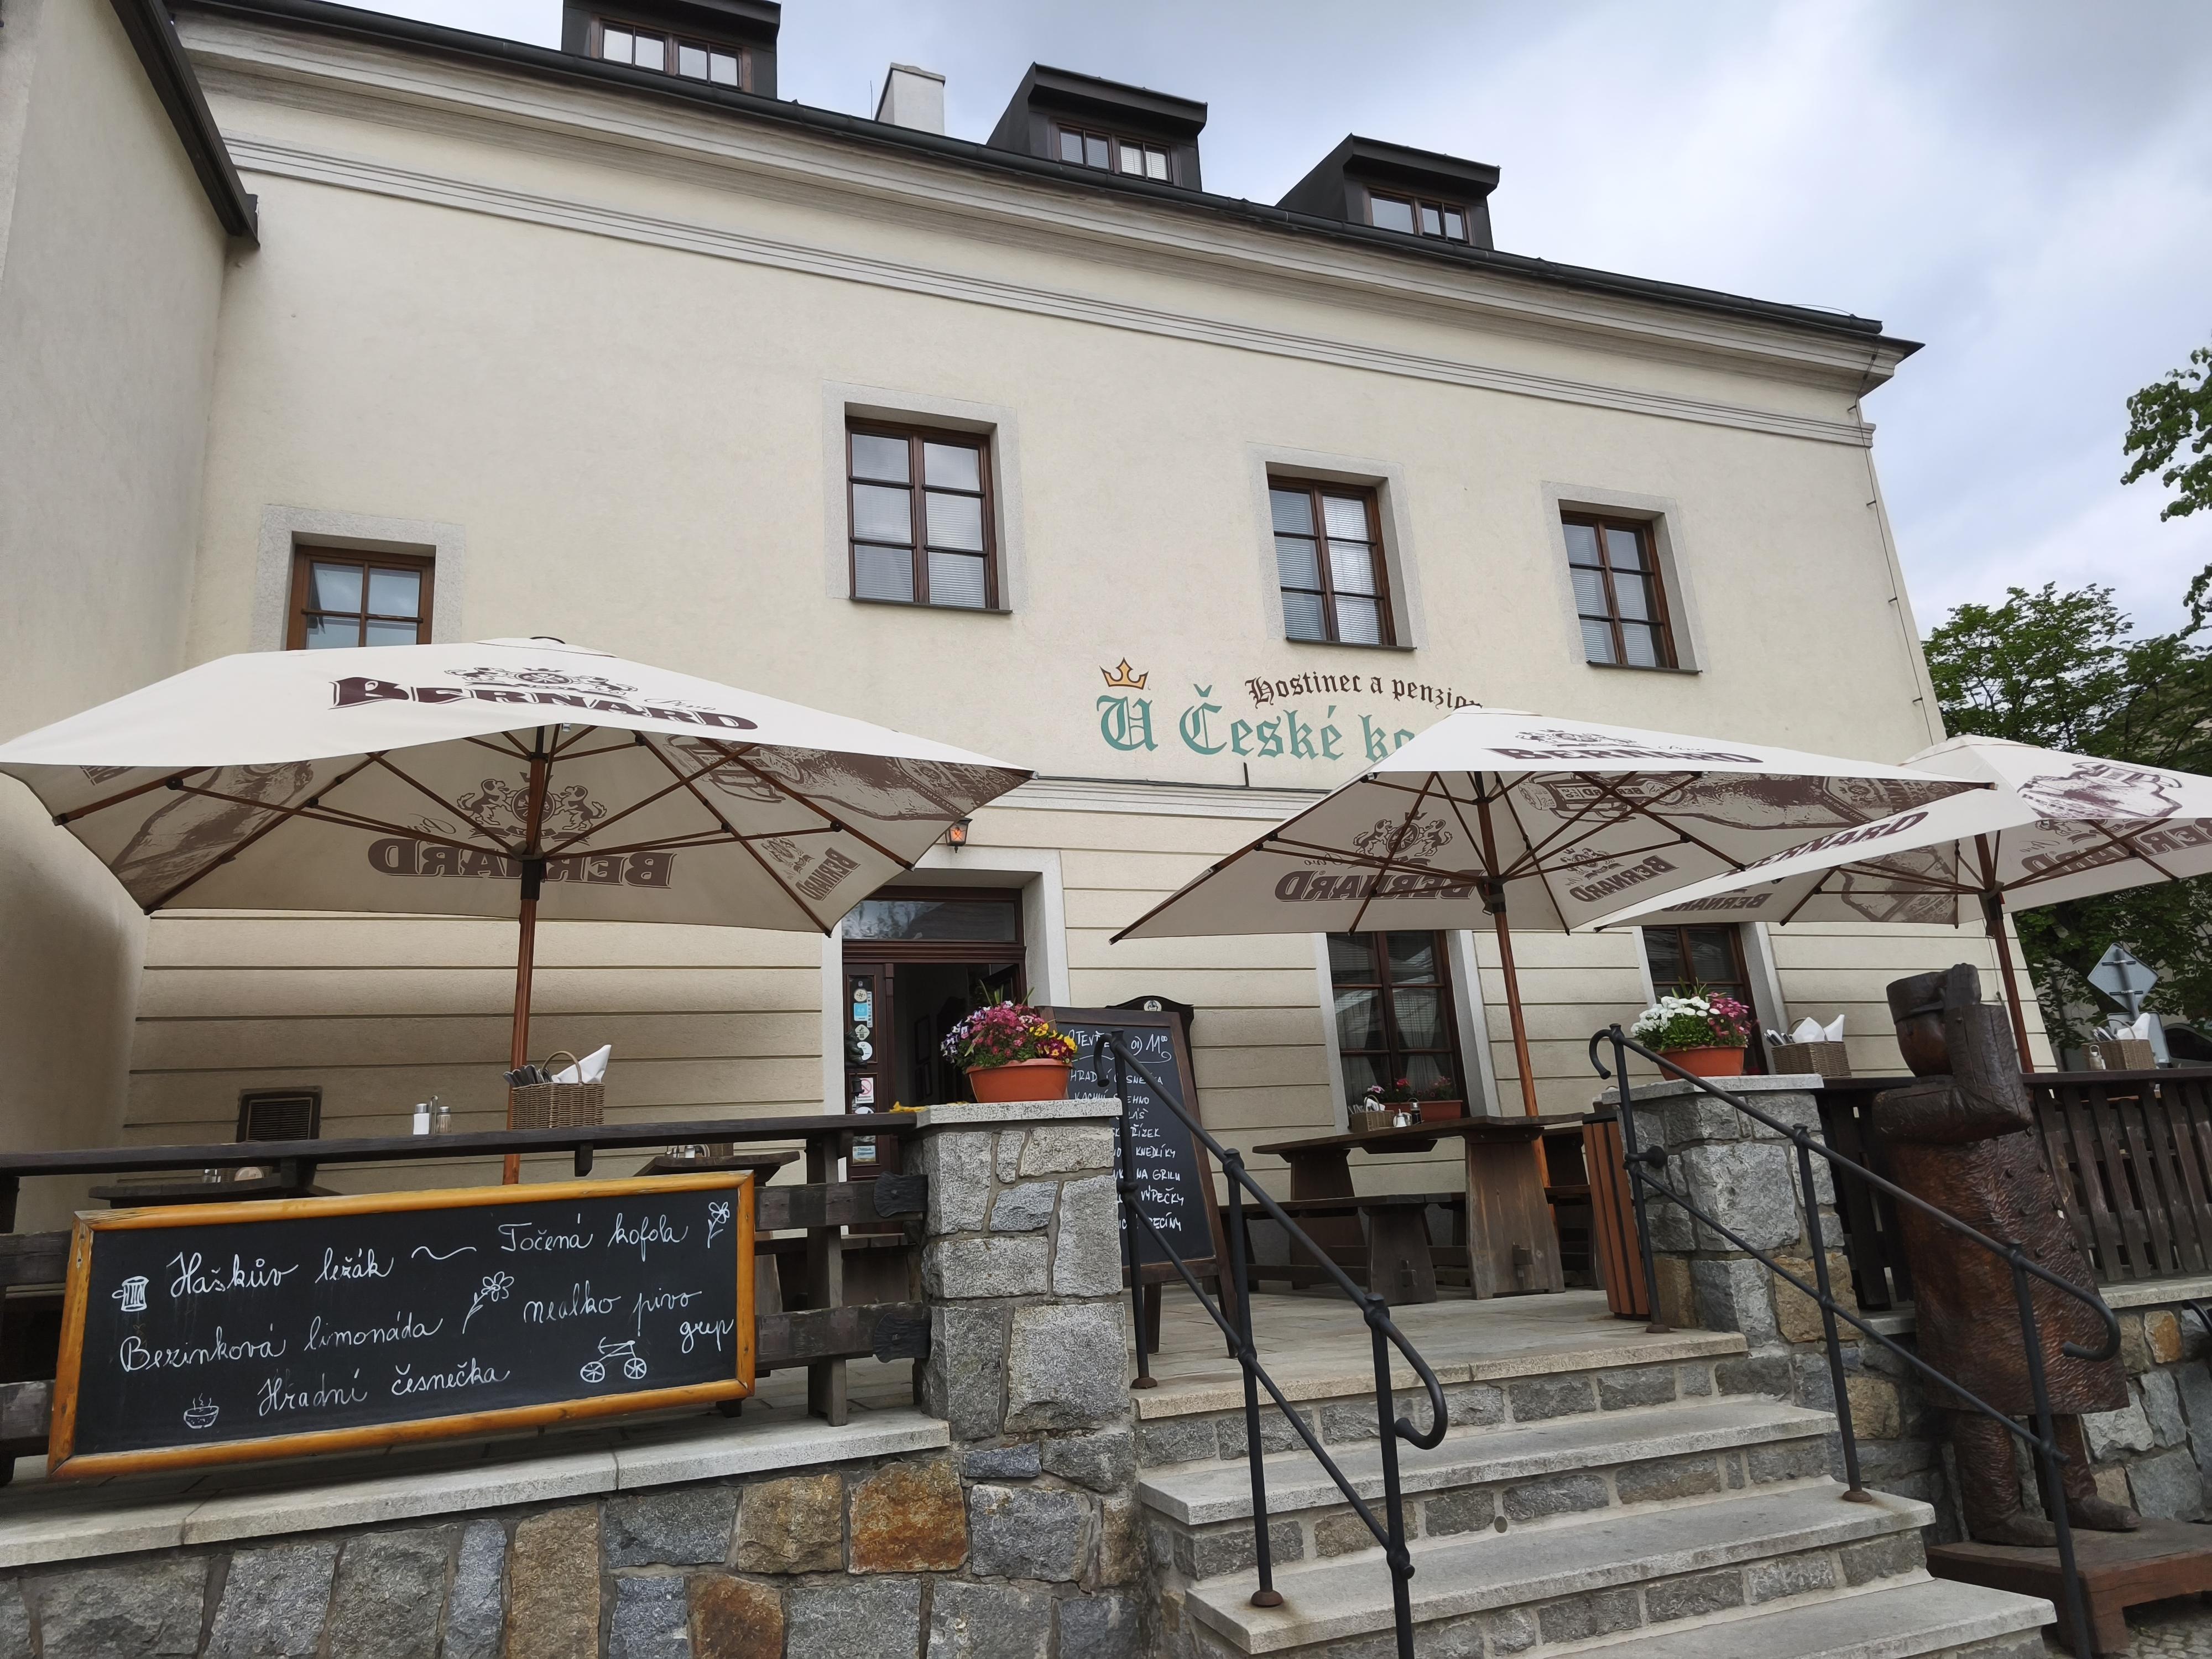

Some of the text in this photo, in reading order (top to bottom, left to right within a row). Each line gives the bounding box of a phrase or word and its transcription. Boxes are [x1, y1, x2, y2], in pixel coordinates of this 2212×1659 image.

[328, 677, 758, 729] BERNARD
[1245, 670, 1483, 711] Hostinec a penzio
[1096, 695, 1159, 752] U
[1179, 684, 1345, 762] České
[1481, 748, 1764, 763] BERNARD
[1136, 1143, 1176, 1159] KNEDLÍKY
[1136, 1167, 1148, 1180] NA
[1152, 1168, 1181, 1181] GRILU
[1141, 1185, 1185, 1206] VÝPEČKY
[166, 1213, 689, 1298] Haškův ležák Točená kofola
[304, 1311, 443, 1353] limonáda
[523, 1280, 622, 1323] nealko
[633, 1287, 702, 1337] pivo
[257, 1357, 510, 1417] Hradní česnečka
